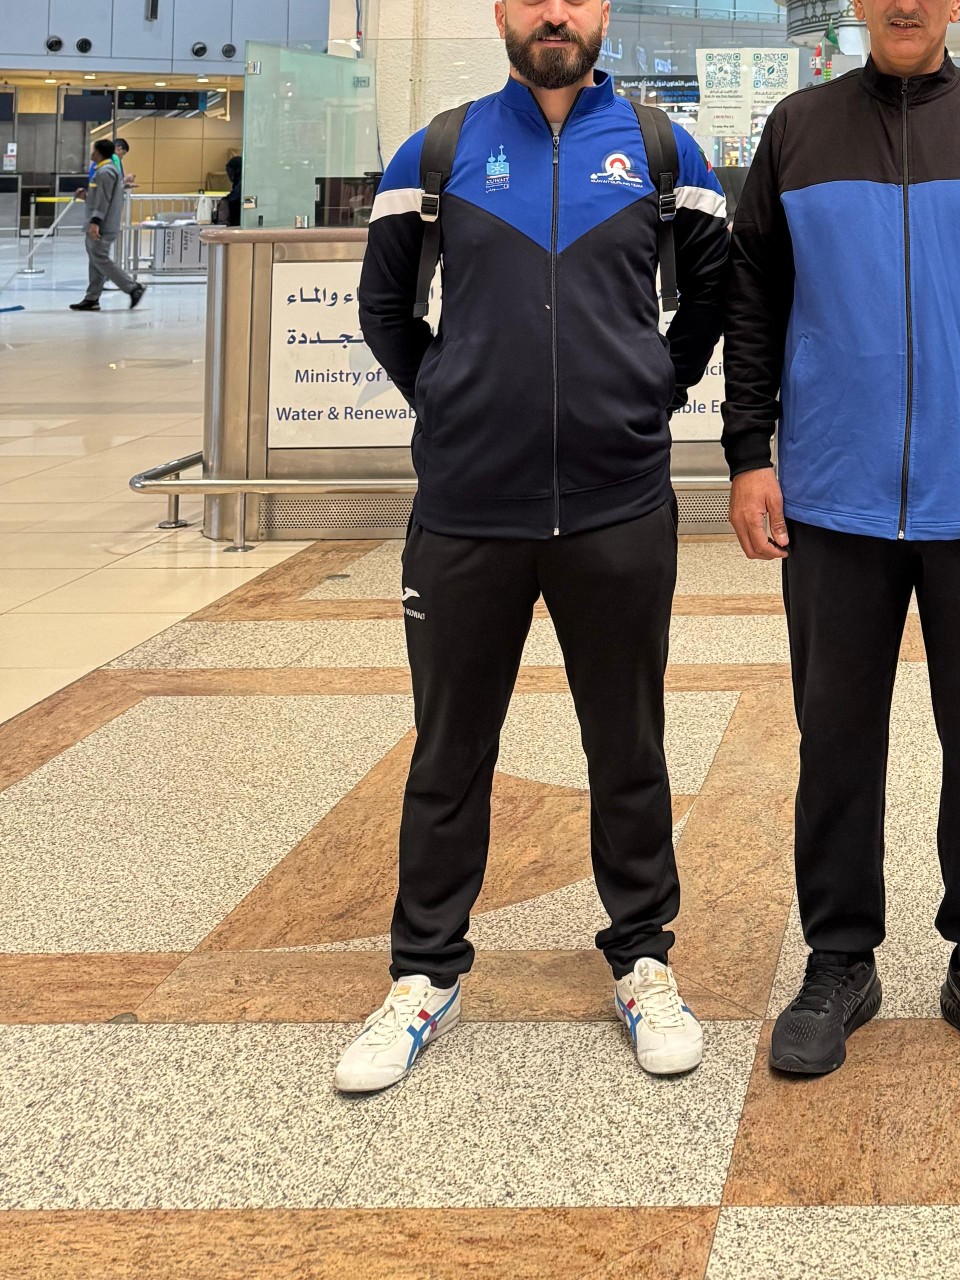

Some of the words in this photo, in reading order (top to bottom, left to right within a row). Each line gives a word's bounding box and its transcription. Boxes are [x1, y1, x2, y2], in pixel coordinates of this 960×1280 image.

[287, 286, 338, 306] والماء
[287, 328, 364, 348] جددة
[295, 369, 361, 386] Ministry
[366, 368, 382, 382] of
[276, 407, 323, 421] Water
[328, 406, 339, 420] &
